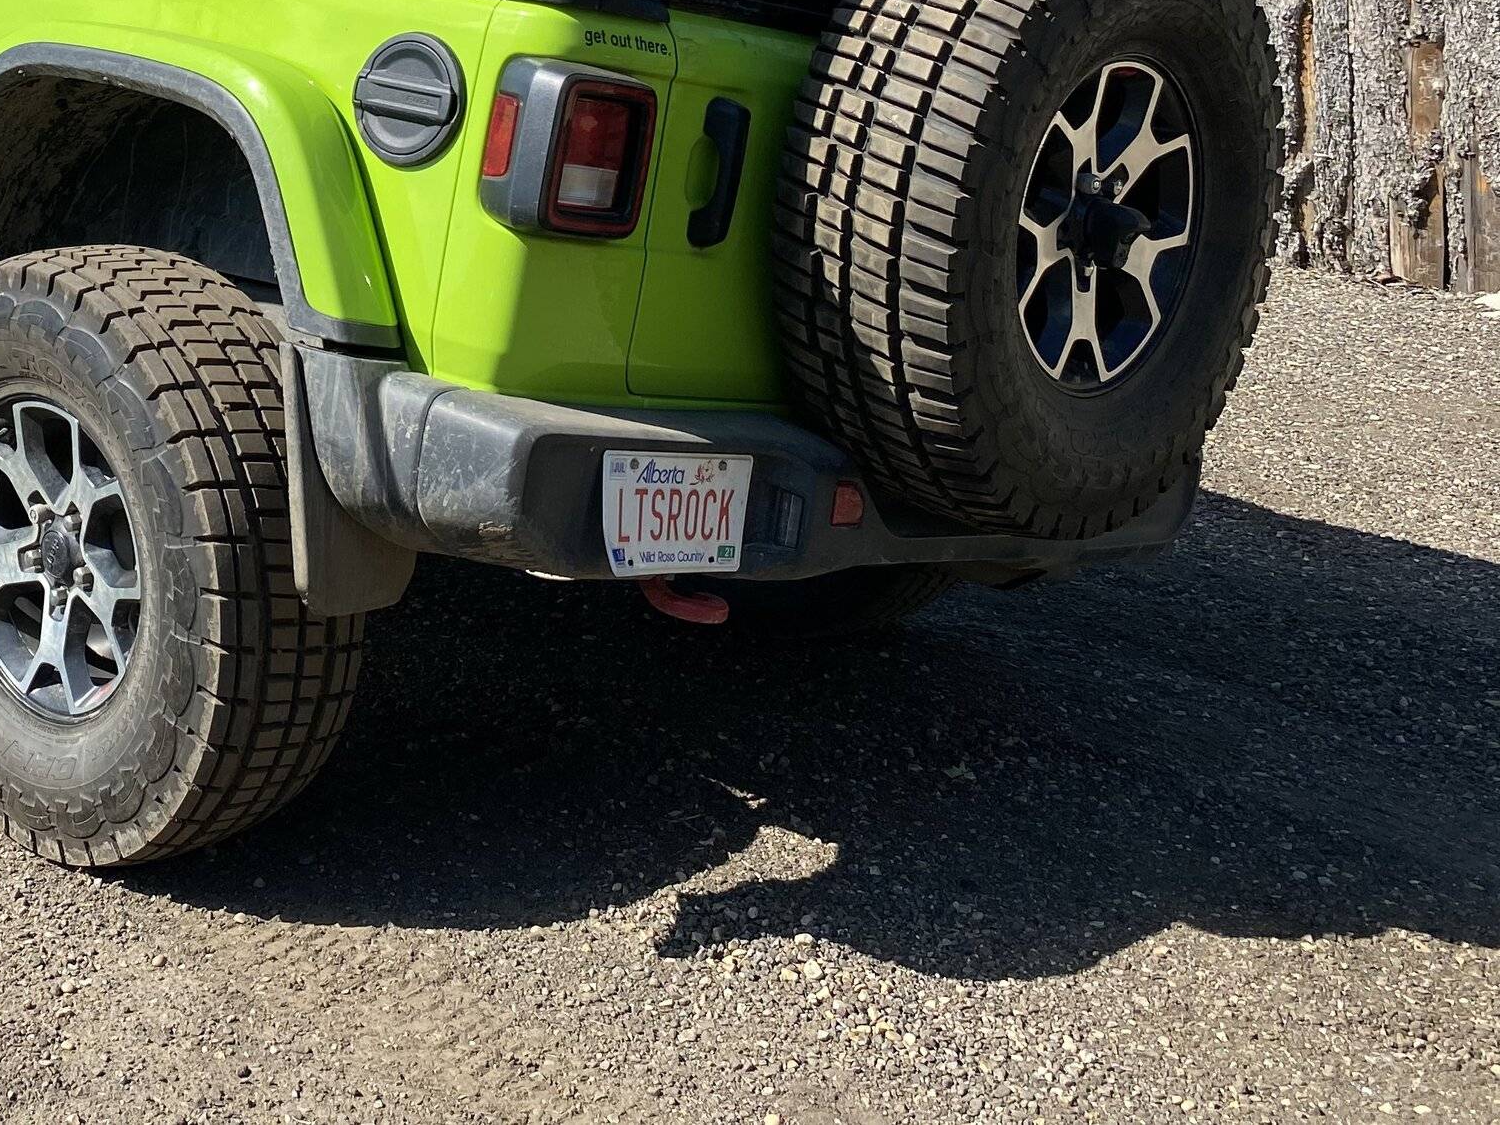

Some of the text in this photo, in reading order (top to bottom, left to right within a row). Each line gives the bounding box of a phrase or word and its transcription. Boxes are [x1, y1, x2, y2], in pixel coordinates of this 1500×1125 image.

[585, 30, 672, 56] get out there.
[636, 459, 685, 485] Alberta
[617, 488, 735, 543] LTSROCK
[640, 551, 655, 563] Wild
[657, 551, 675, 563] Rose
